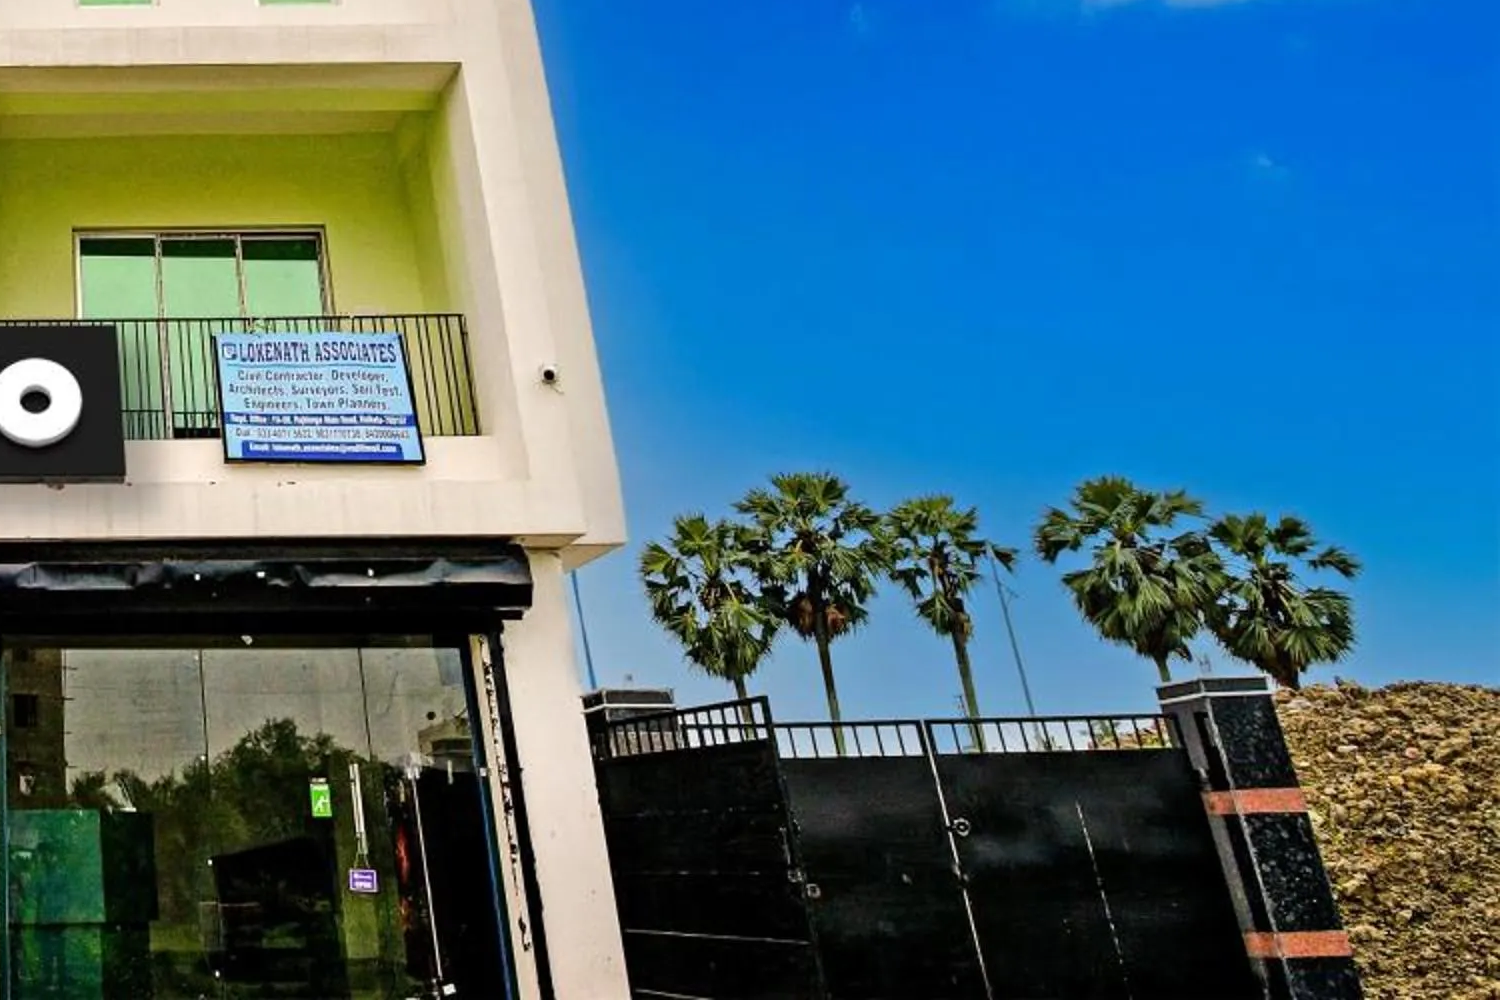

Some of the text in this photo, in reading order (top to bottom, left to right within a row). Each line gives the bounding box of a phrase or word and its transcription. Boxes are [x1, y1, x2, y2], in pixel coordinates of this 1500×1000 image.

[239, 341, 397, 362] LOKENATH ASSOCIATES
[306, 397, 335, 409] Town
